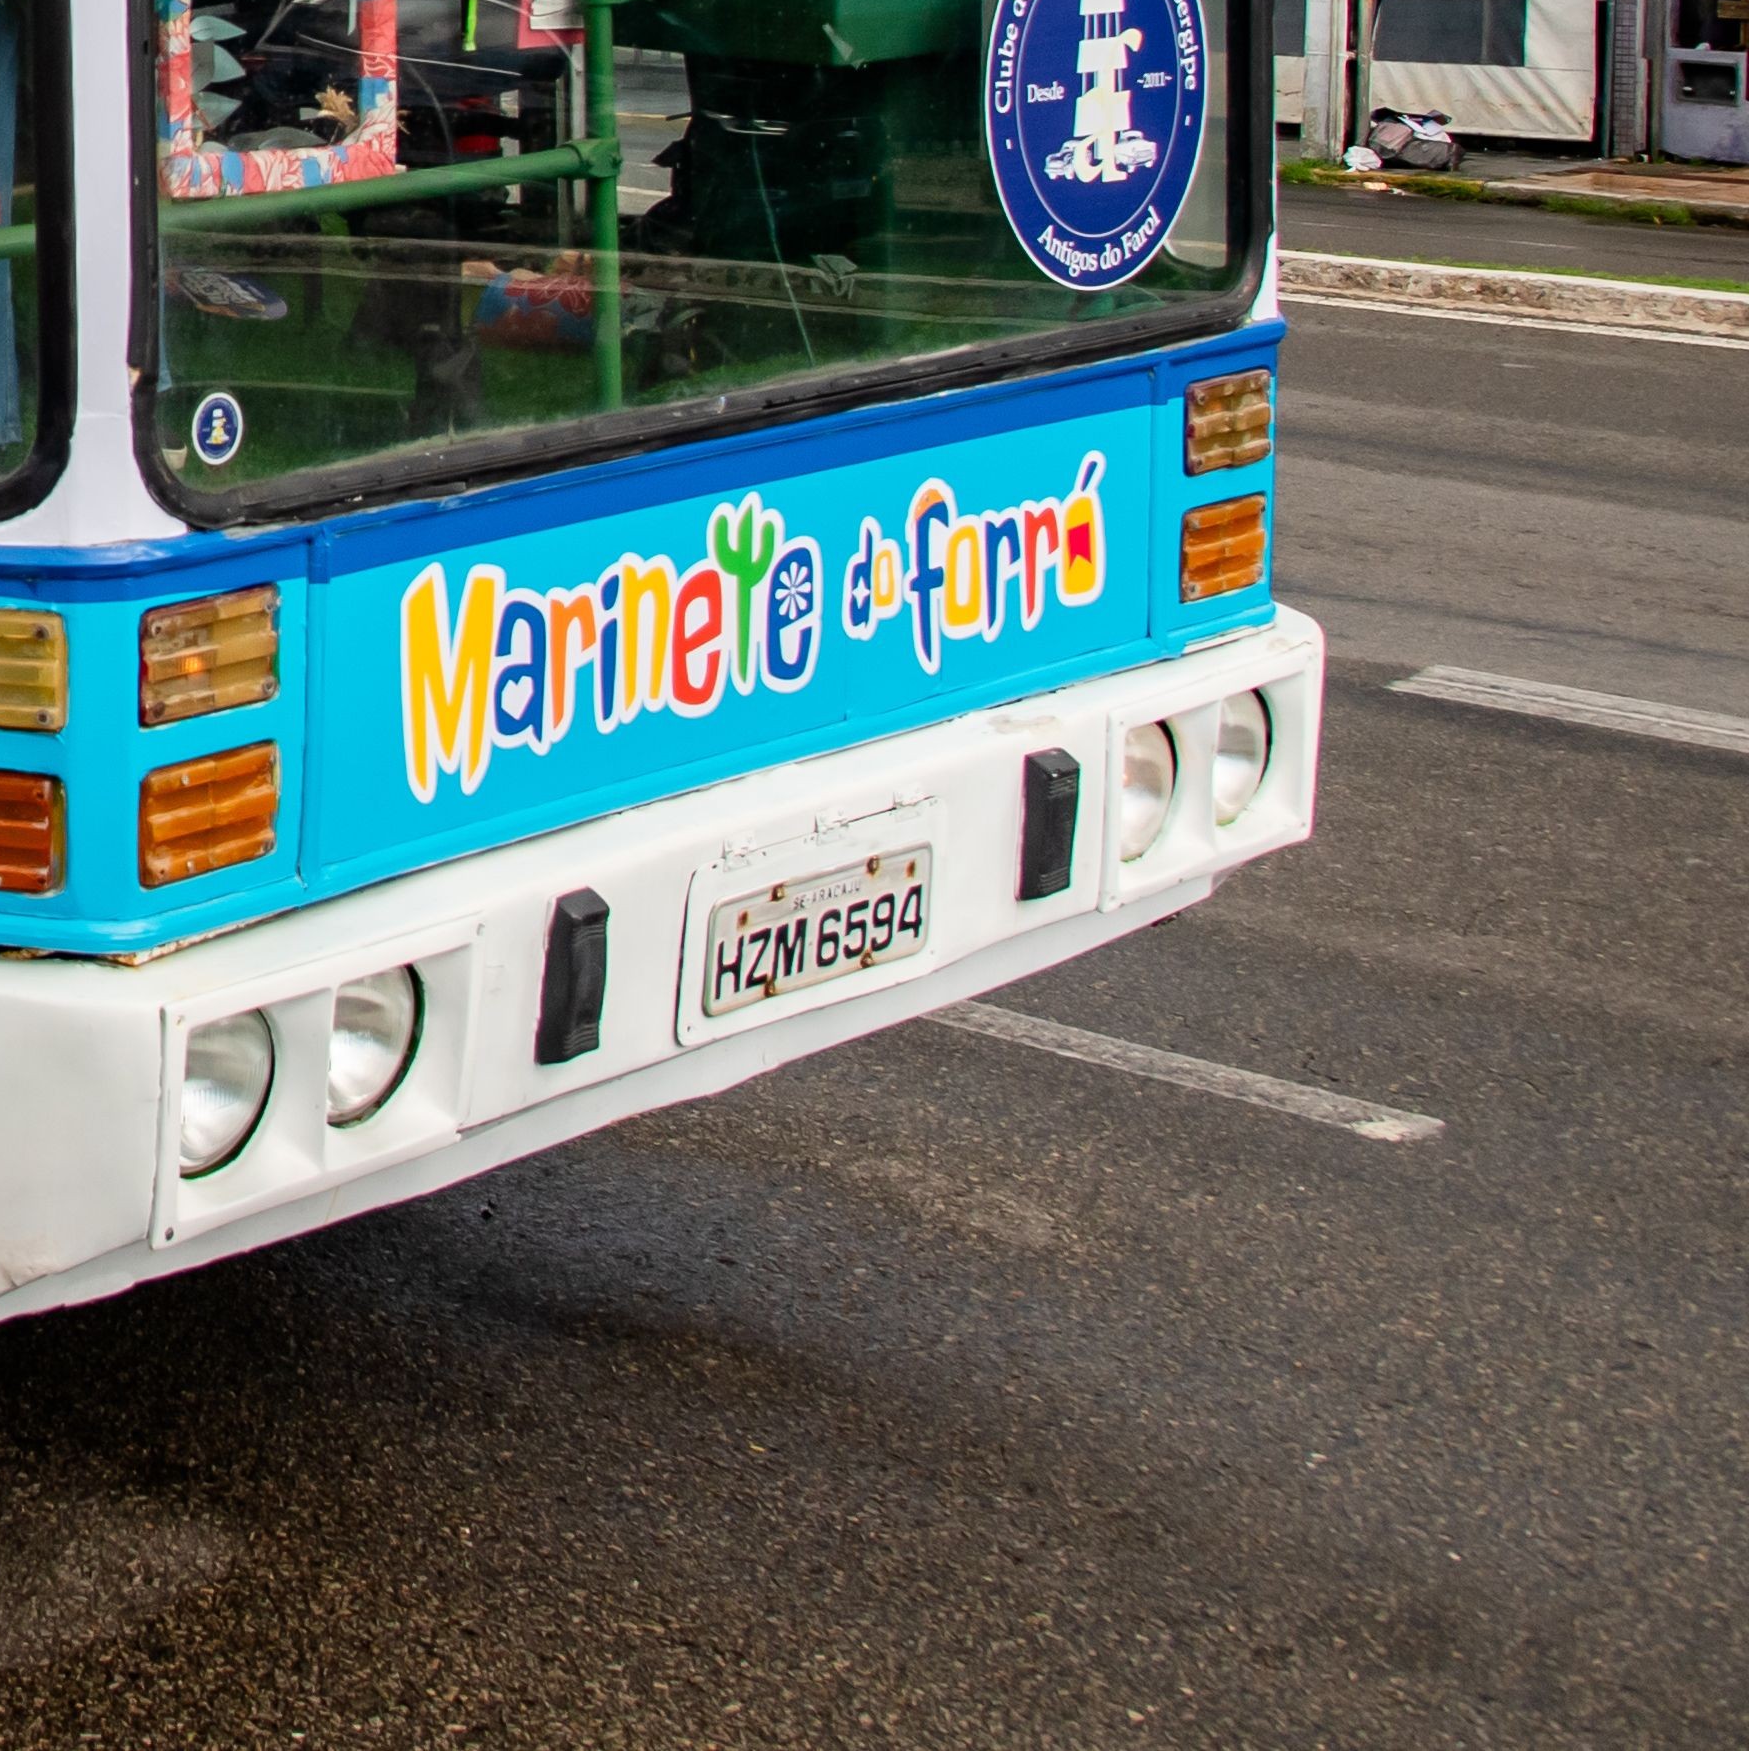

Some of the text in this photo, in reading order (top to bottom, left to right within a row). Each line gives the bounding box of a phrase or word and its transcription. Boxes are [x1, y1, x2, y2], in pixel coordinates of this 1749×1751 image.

[995, 22, 1019, 114] Clube
[1027, 81, 1065, 103] Desde
[1037, 206, 1161, 277] Antigos do Farol
[402, 450, 1106, 803] Marinete do forró
[792, 879, 862, 910] SE-ARACAJU
[715, 884, 923, 1000] HZM 6594
